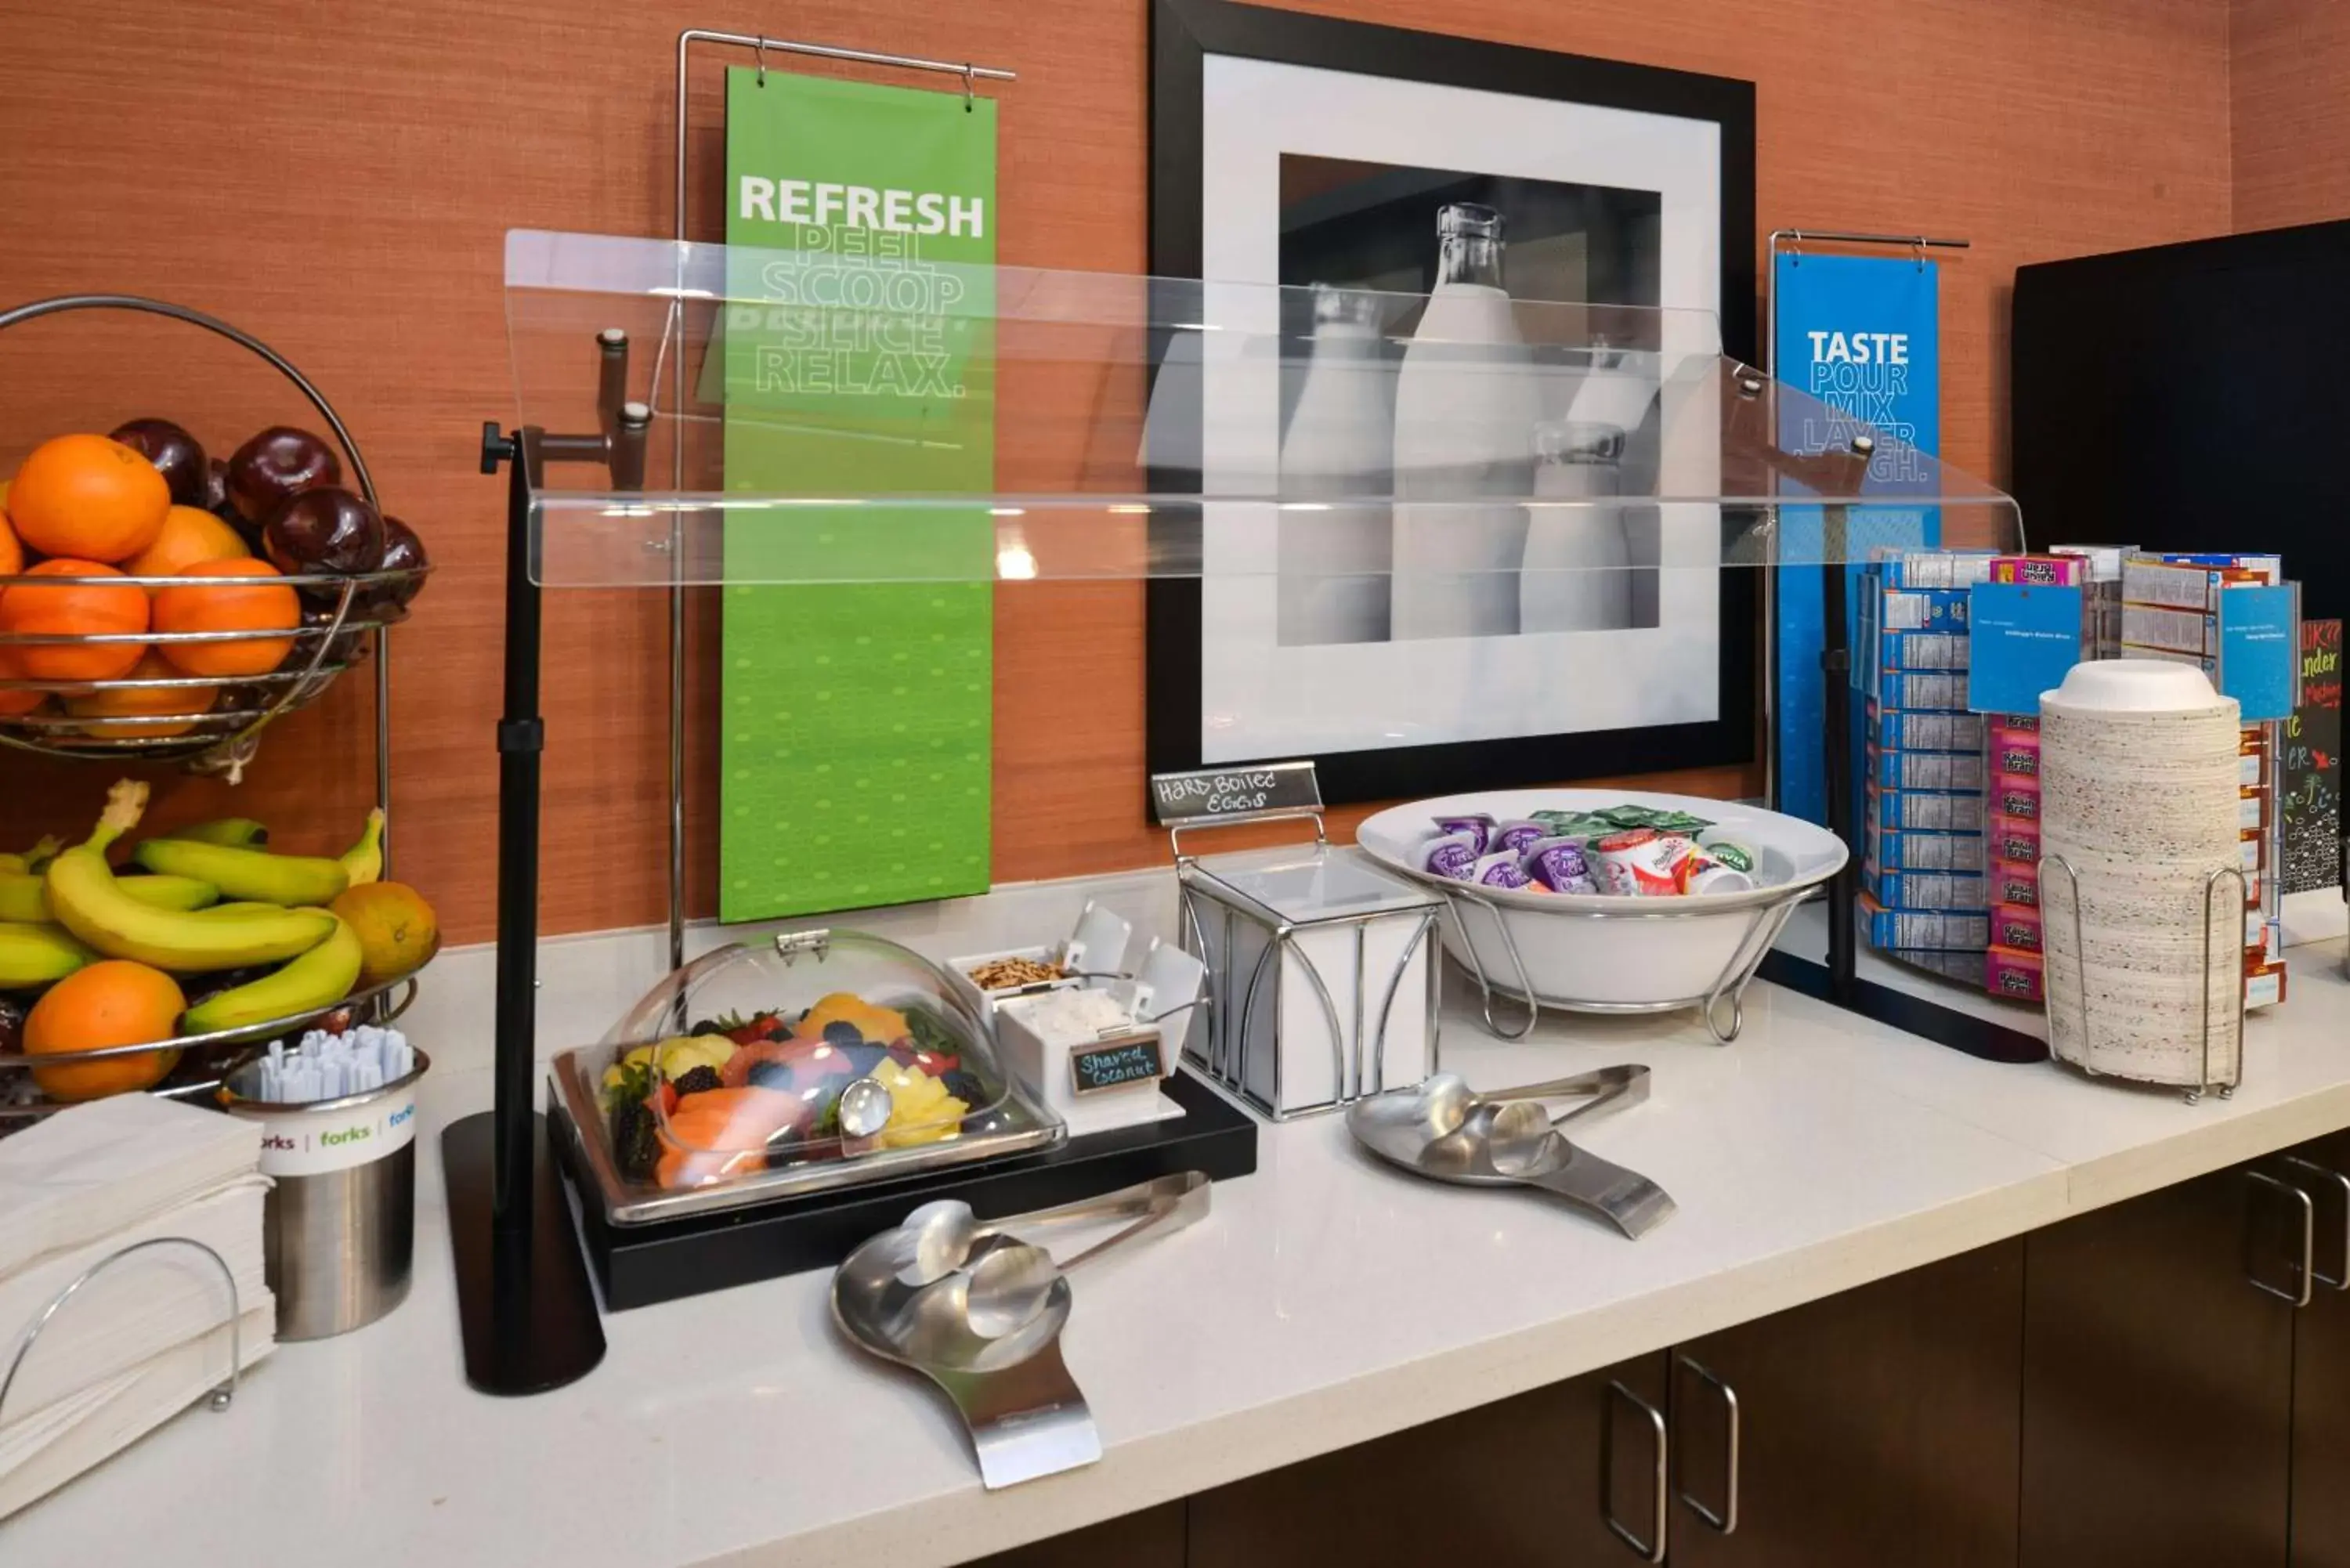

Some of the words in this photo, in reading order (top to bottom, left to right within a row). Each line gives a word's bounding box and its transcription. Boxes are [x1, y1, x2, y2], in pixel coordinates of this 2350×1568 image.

[740, 175, 983, 237] REFRESH
[795, 223, 934, 272] PEEL
[761, 262, 964, 314] SCOOP
[783, 305, 945, 355] SLICE
[1808, 331, 1909, 364] TASTE
[756, 346, 967, 399] RELAX.
[1810, 360, 1908, 395] POUR
[1824, 392, 1896, 425] MIX
[1079, 1046, 1148, 1074] Shaved
[320, 1125, 371, 1147] forks
